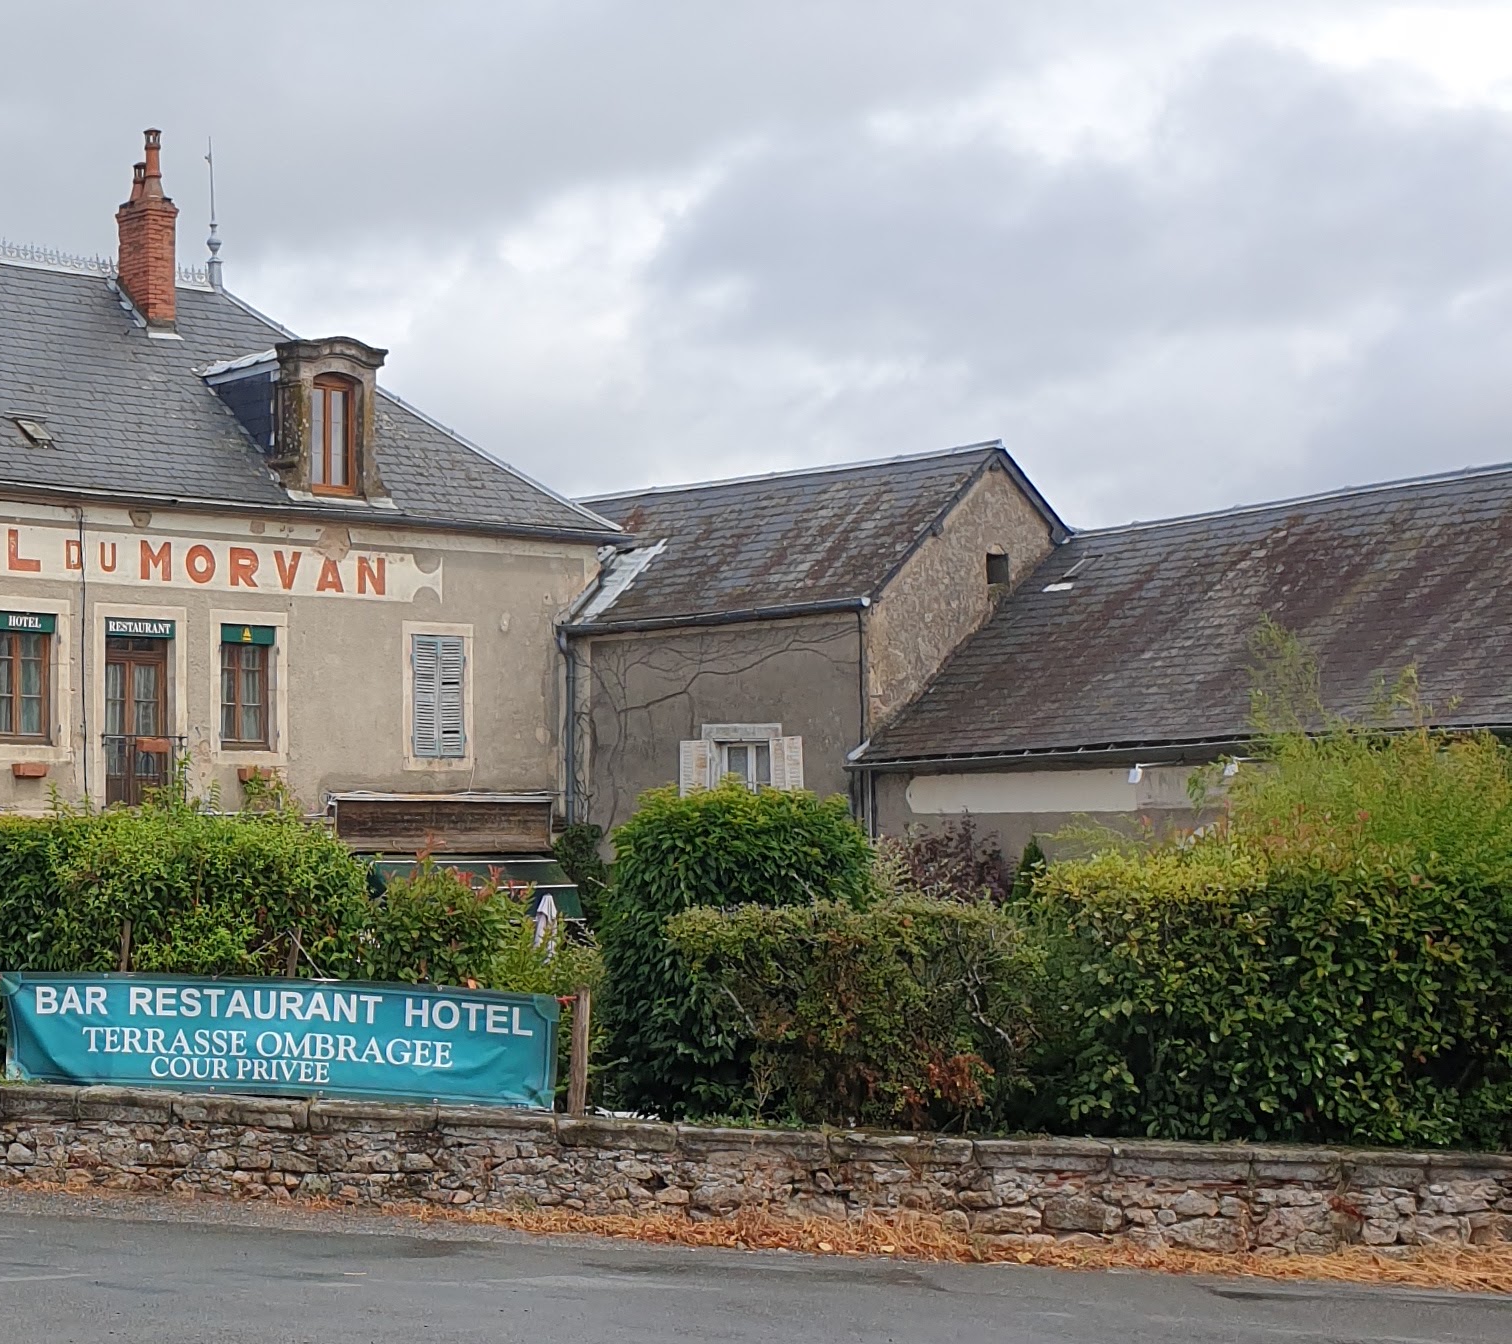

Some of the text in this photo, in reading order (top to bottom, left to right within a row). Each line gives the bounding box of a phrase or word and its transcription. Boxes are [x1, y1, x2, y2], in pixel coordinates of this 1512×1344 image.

[66, 539, 117, 573] DU
[140, 539, 386, 596] MORVAN
[8, 615, 42, 628] HOTEL
[108, 620, 171, 635] RESTAURANT
[35, 986, 533, 1037] BAR RESTAURANT HOTEL
[82, 1026, 454, 1068] TERRASSE OMBRAGEE
[150, 1056, 330, 1083] COUR PRIVEE
